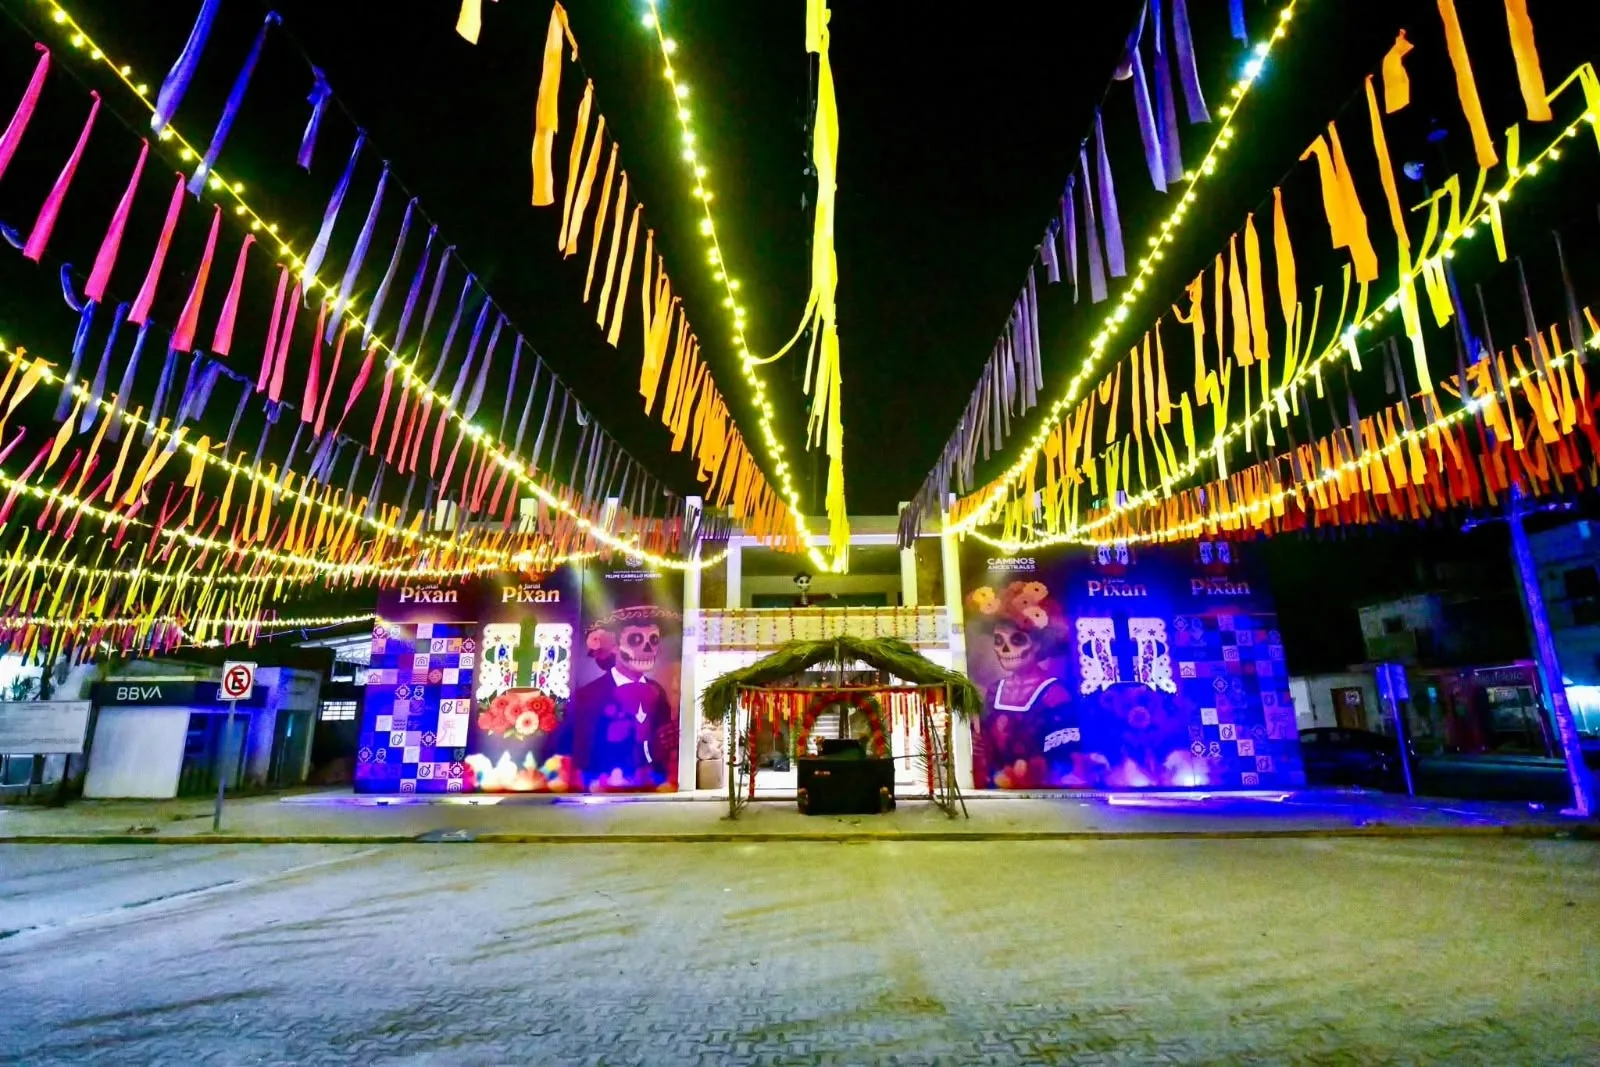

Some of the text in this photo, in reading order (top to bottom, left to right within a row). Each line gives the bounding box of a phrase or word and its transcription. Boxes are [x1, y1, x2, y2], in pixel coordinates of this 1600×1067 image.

[987, 557, 1036, 565] CAMINOS
[399, 585, 458, 603] Pixan
[502, 584, 560, 603] Pixan
[1087, 579, 1148, 597] Pixan
[1190, 578, 1251, 596] Pixan
[231, 671, 246, 690] E
[116, 686, 162, 700] BBVA
